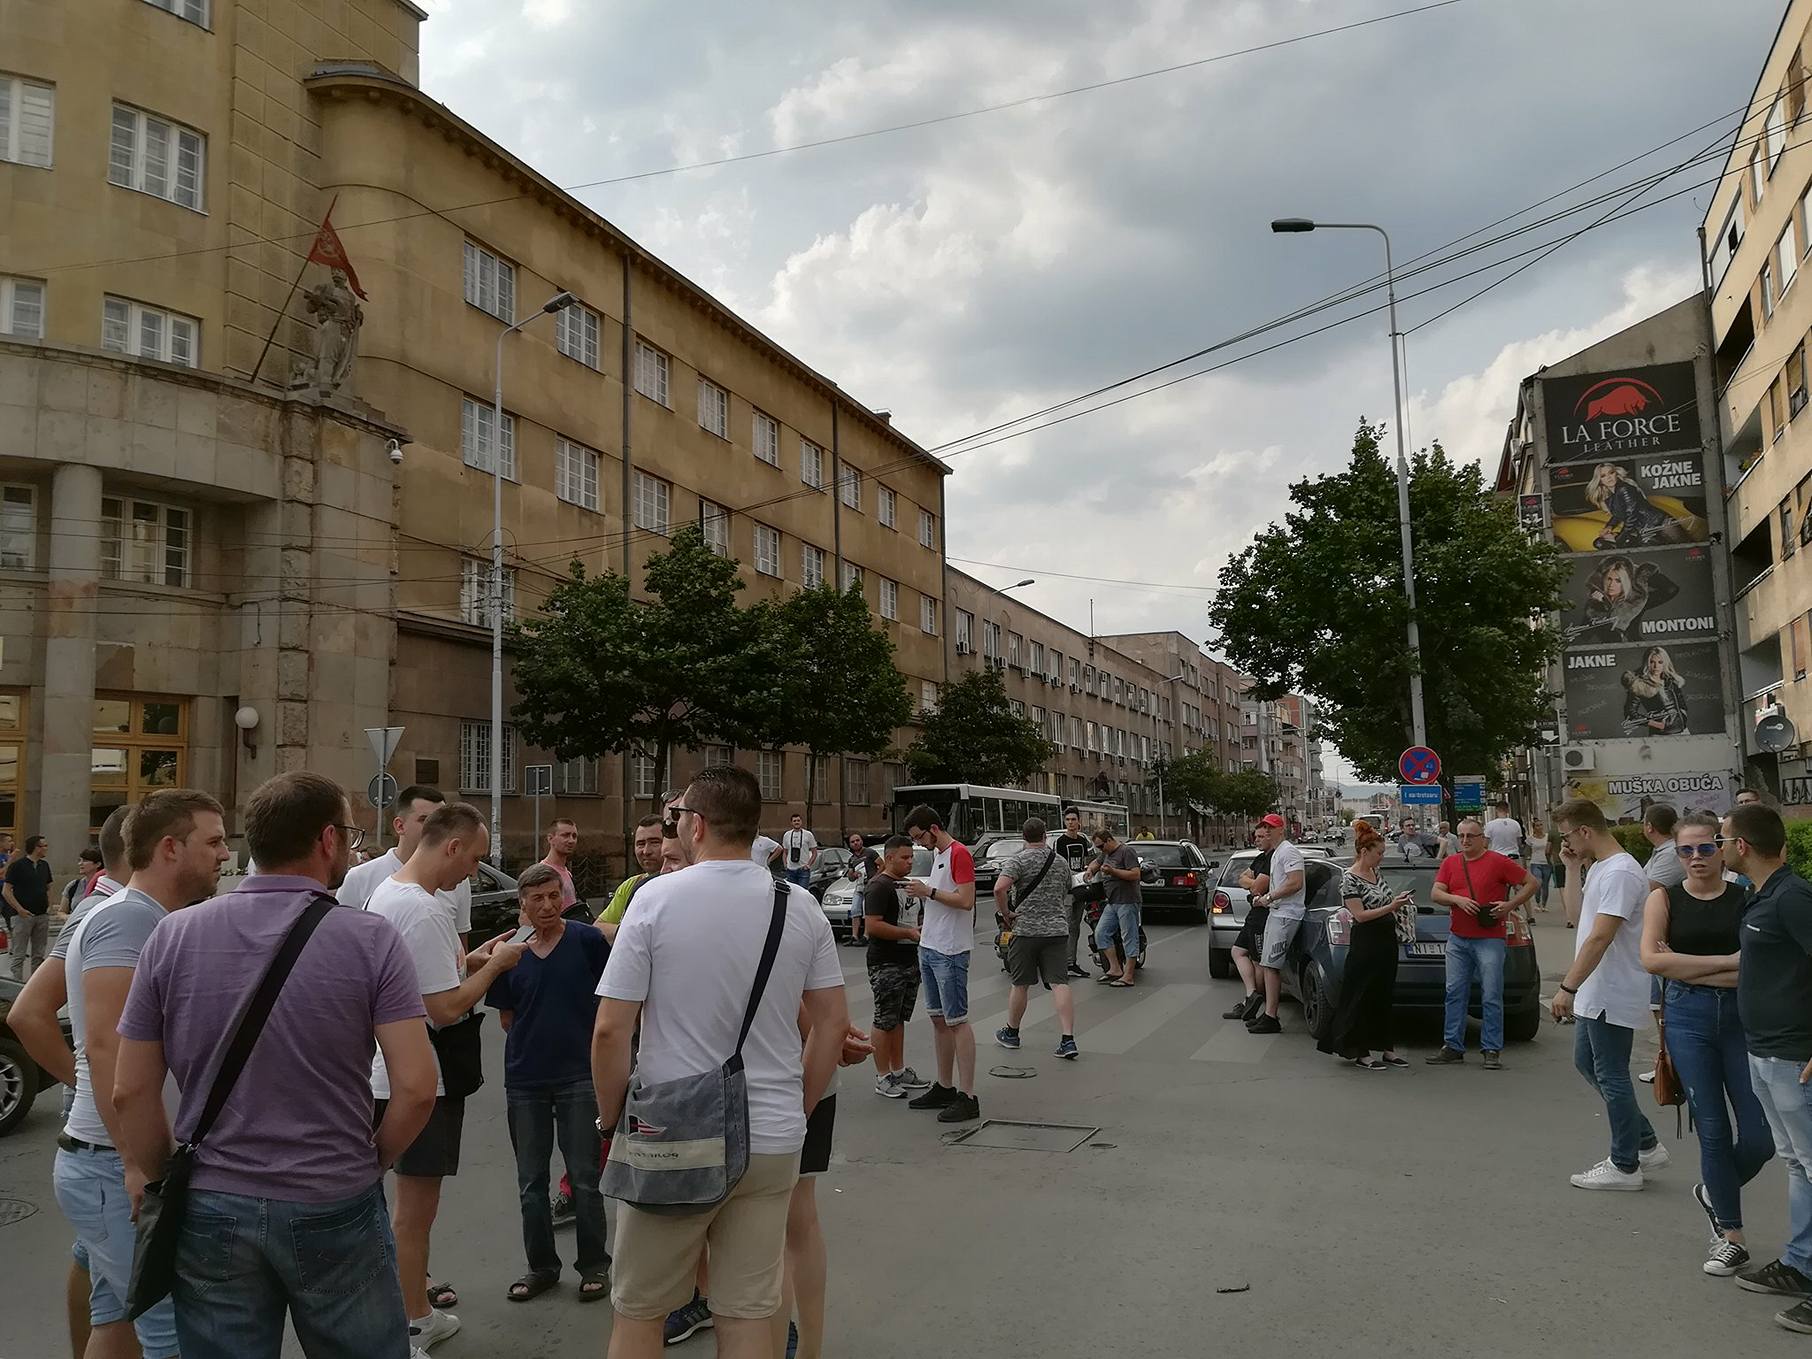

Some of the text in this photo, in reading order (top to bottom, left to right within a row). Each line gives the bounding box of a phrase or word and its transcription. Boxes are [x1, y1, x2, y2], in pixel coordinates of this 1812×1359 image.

[1562, 414, 1681, 444] LA FORCE
[1584, 437, 1662, 453] LEATHER
[1640, 460, 1693, 478] KOŽNE
[1652, 473, 1702, 490] JAKNE
[1641, 616, 1715, 634] MONTONI
[1567, 654, 1616, 669] JAKNE
[1608, 774, 1723, 795] MUŠKA OBUĆA
